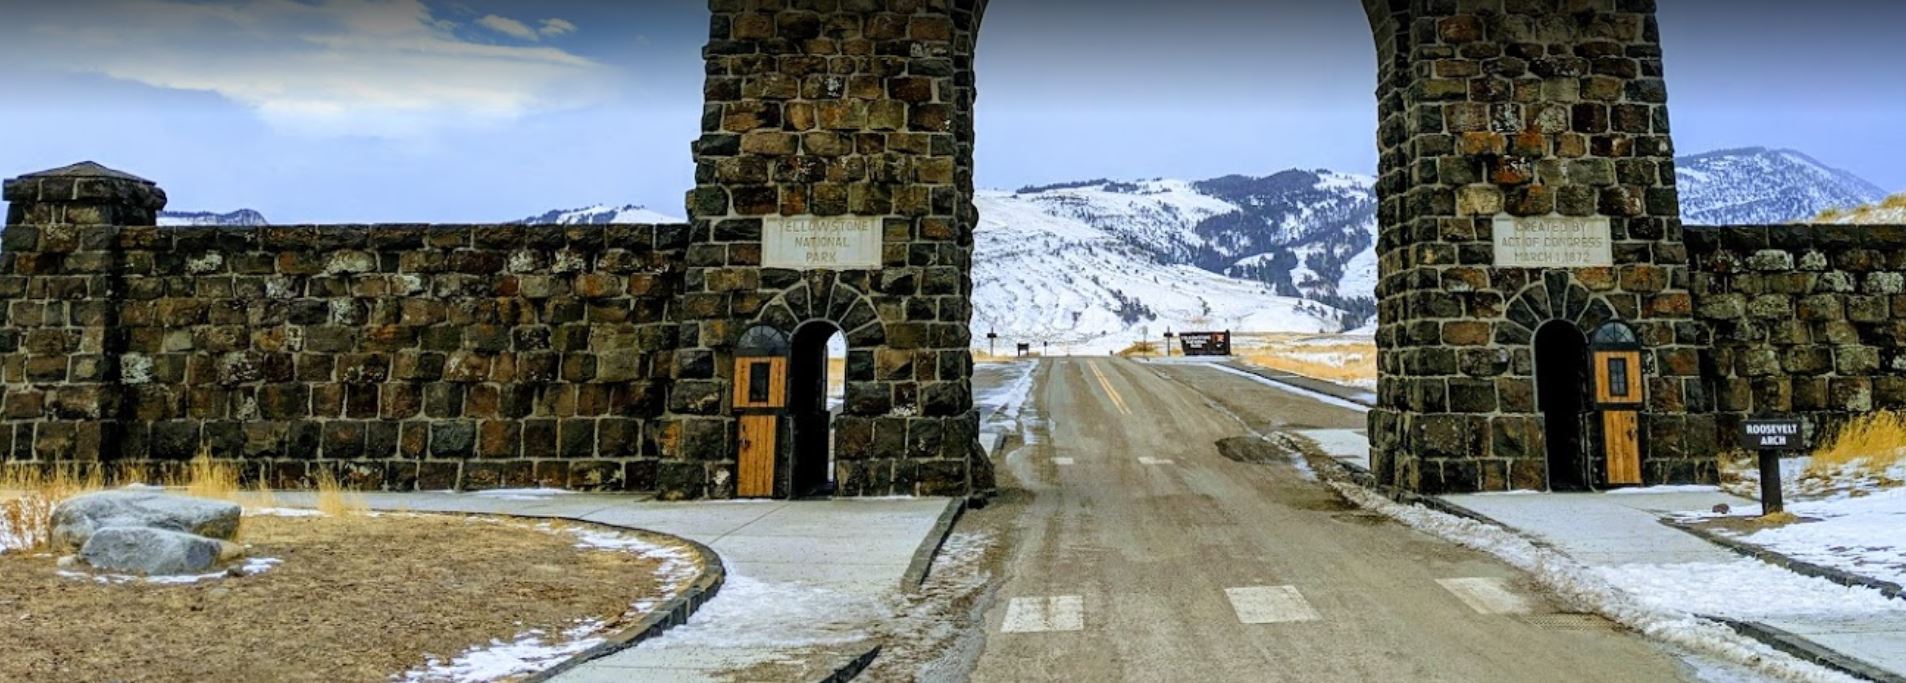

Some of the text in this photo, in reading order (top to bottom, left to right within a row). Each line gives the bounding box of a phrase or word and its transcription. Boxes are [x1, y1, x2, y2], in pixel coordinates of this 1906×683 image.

[779, 220, 869, 232] YELLOWSTONE
[1515, 221, 1587, 233] CREATED BY
[794, 236, 850, 248] NATIONAL
[1501, 236, 1603, 248] ACT OF CONGRESS
[806, 251, 837, 263] PARK
[1514, 251, 1553, 262] MARCH
[1746, 424, 1797, 434] ROOSEVELT
[1760, 435, 1786, 445] ARCH
